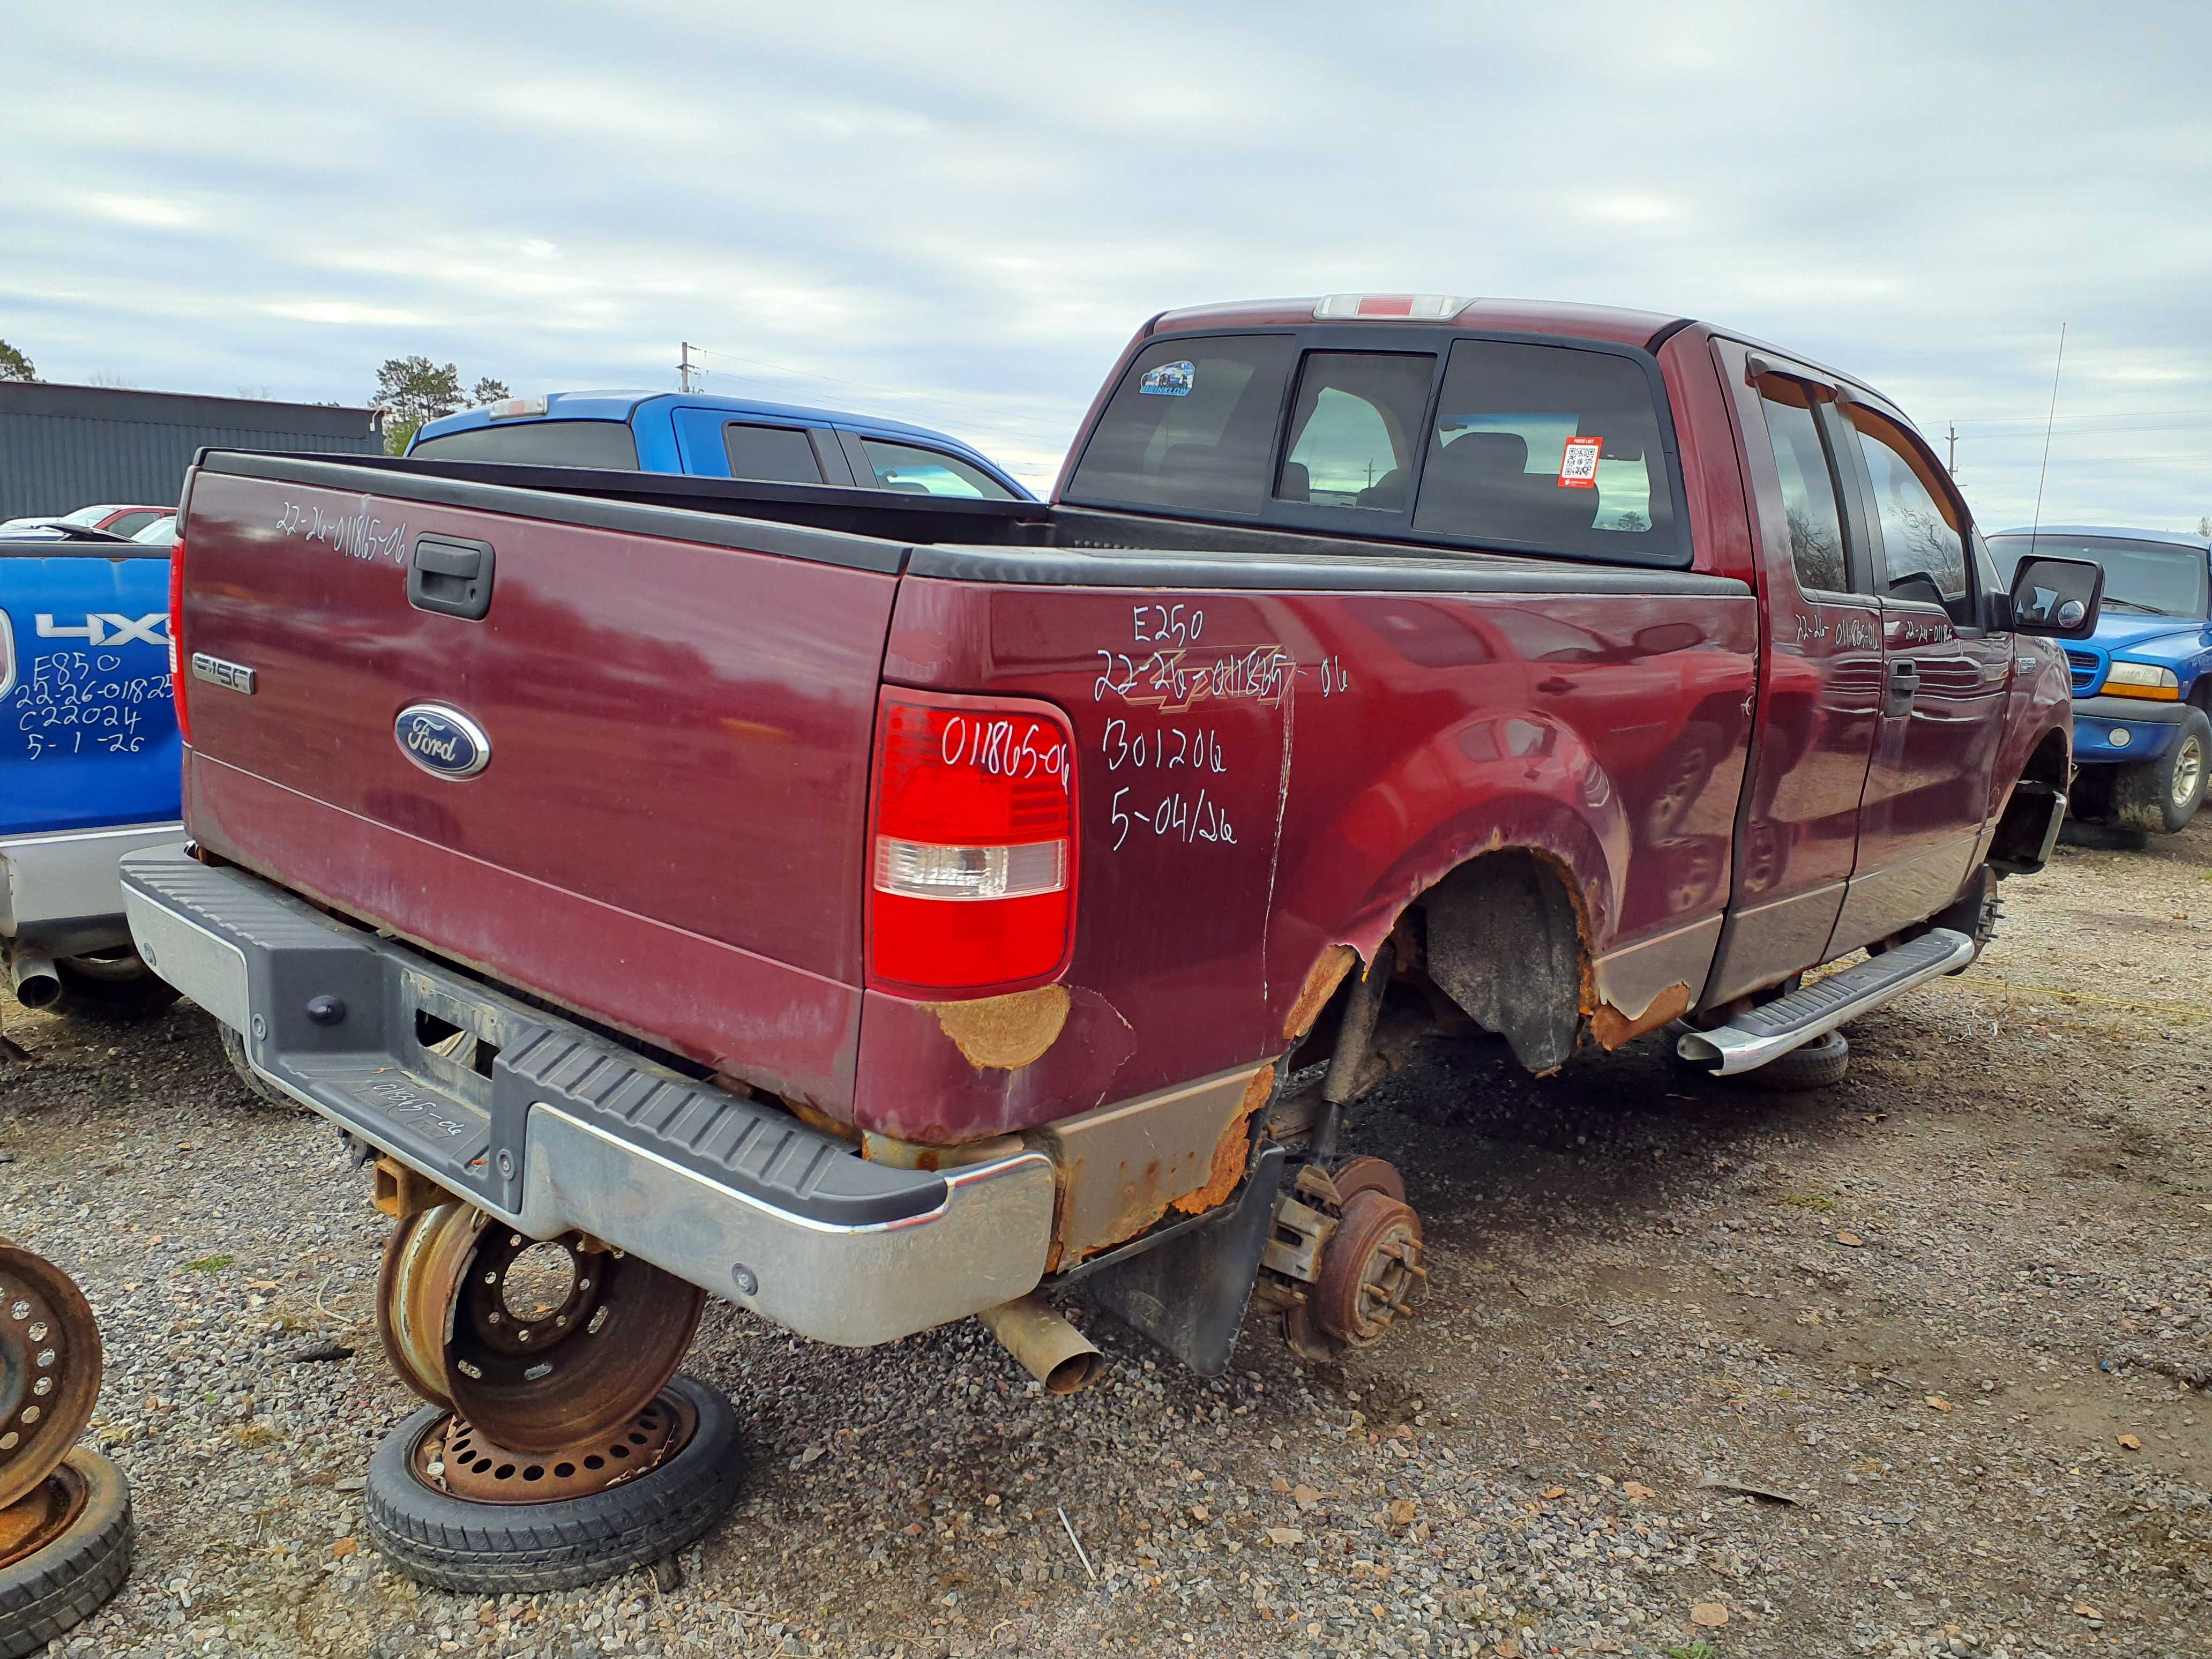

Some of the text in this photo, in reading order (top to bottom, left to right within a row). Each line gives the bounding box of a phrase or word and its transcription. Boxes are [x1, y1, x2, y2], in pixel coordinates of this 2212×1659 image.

[1142, 386, 1189, 394] BRINKLOW
[34, 614, 171, 646] 4X
[1133, 604, 1203, 647] E250
[408, 716, 457, 761] Ford
[942, 716, 1070, 795] 011865-06
[1102, 717, 1227, 773] B01206
[1111, 786, 1237, 851] 5-04/26
